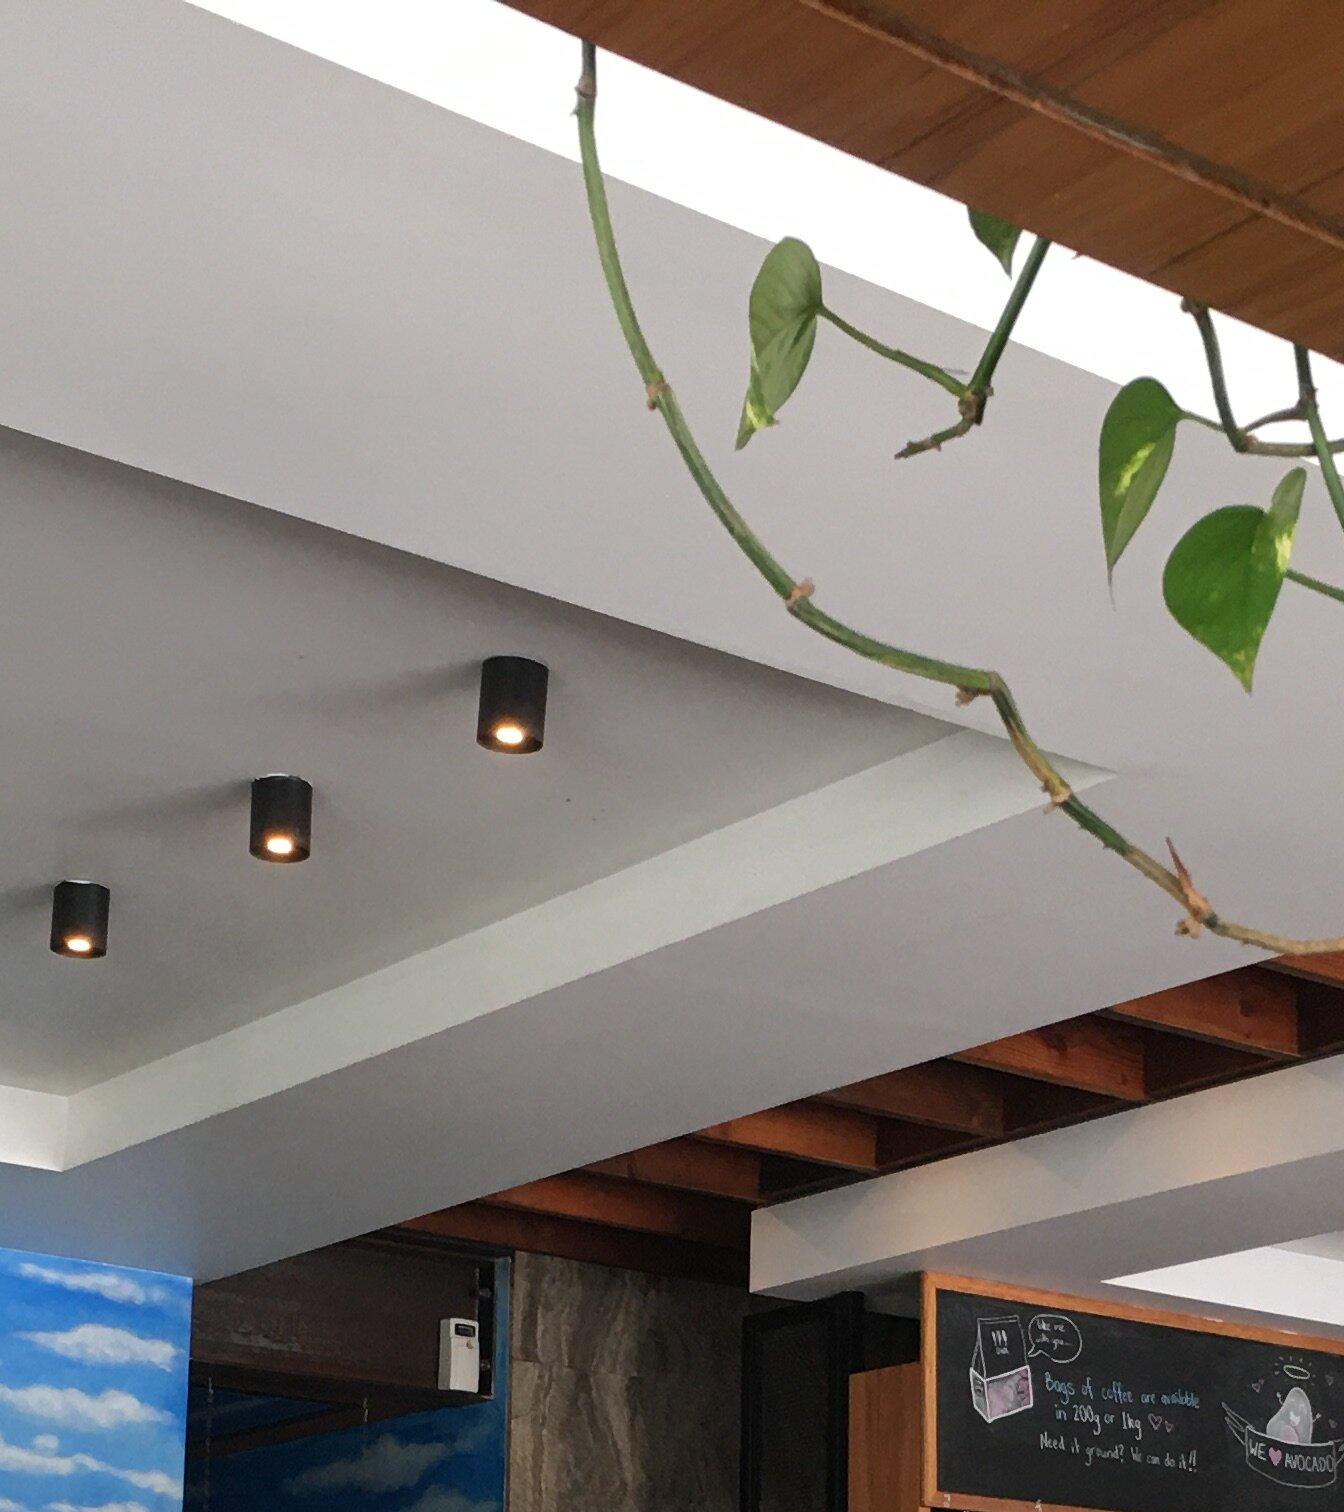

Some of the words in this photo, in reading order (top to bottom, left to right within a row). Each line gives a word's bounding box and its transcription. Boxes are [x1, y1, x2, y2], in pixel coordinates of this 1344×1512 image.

[1081, 1376, 1094, 1400] of
[1101, 1380, 1133, 1404] coffee
[1140, 1392, 1156, 1405] are
[1054, 1403, 1067, 1421] in
[1072, 1404, 1101, 1436] 200g
[1103, 1413, 1115, 1424] or
[1122, 1411, 1142, 1441] 1kg
[1039, 1431, 1065, 1451] Need
[1070, 1437, 1080, 1454] it
[1085, 1443, 1125, 1466] ground?
[1145, 1455, 1161, 1466] can
[1164, 1452, 1176, 1468] do
[1249, 1438, 1267, 1461] WE
[1284, 1452, 1335, 1473] AVOCADO
